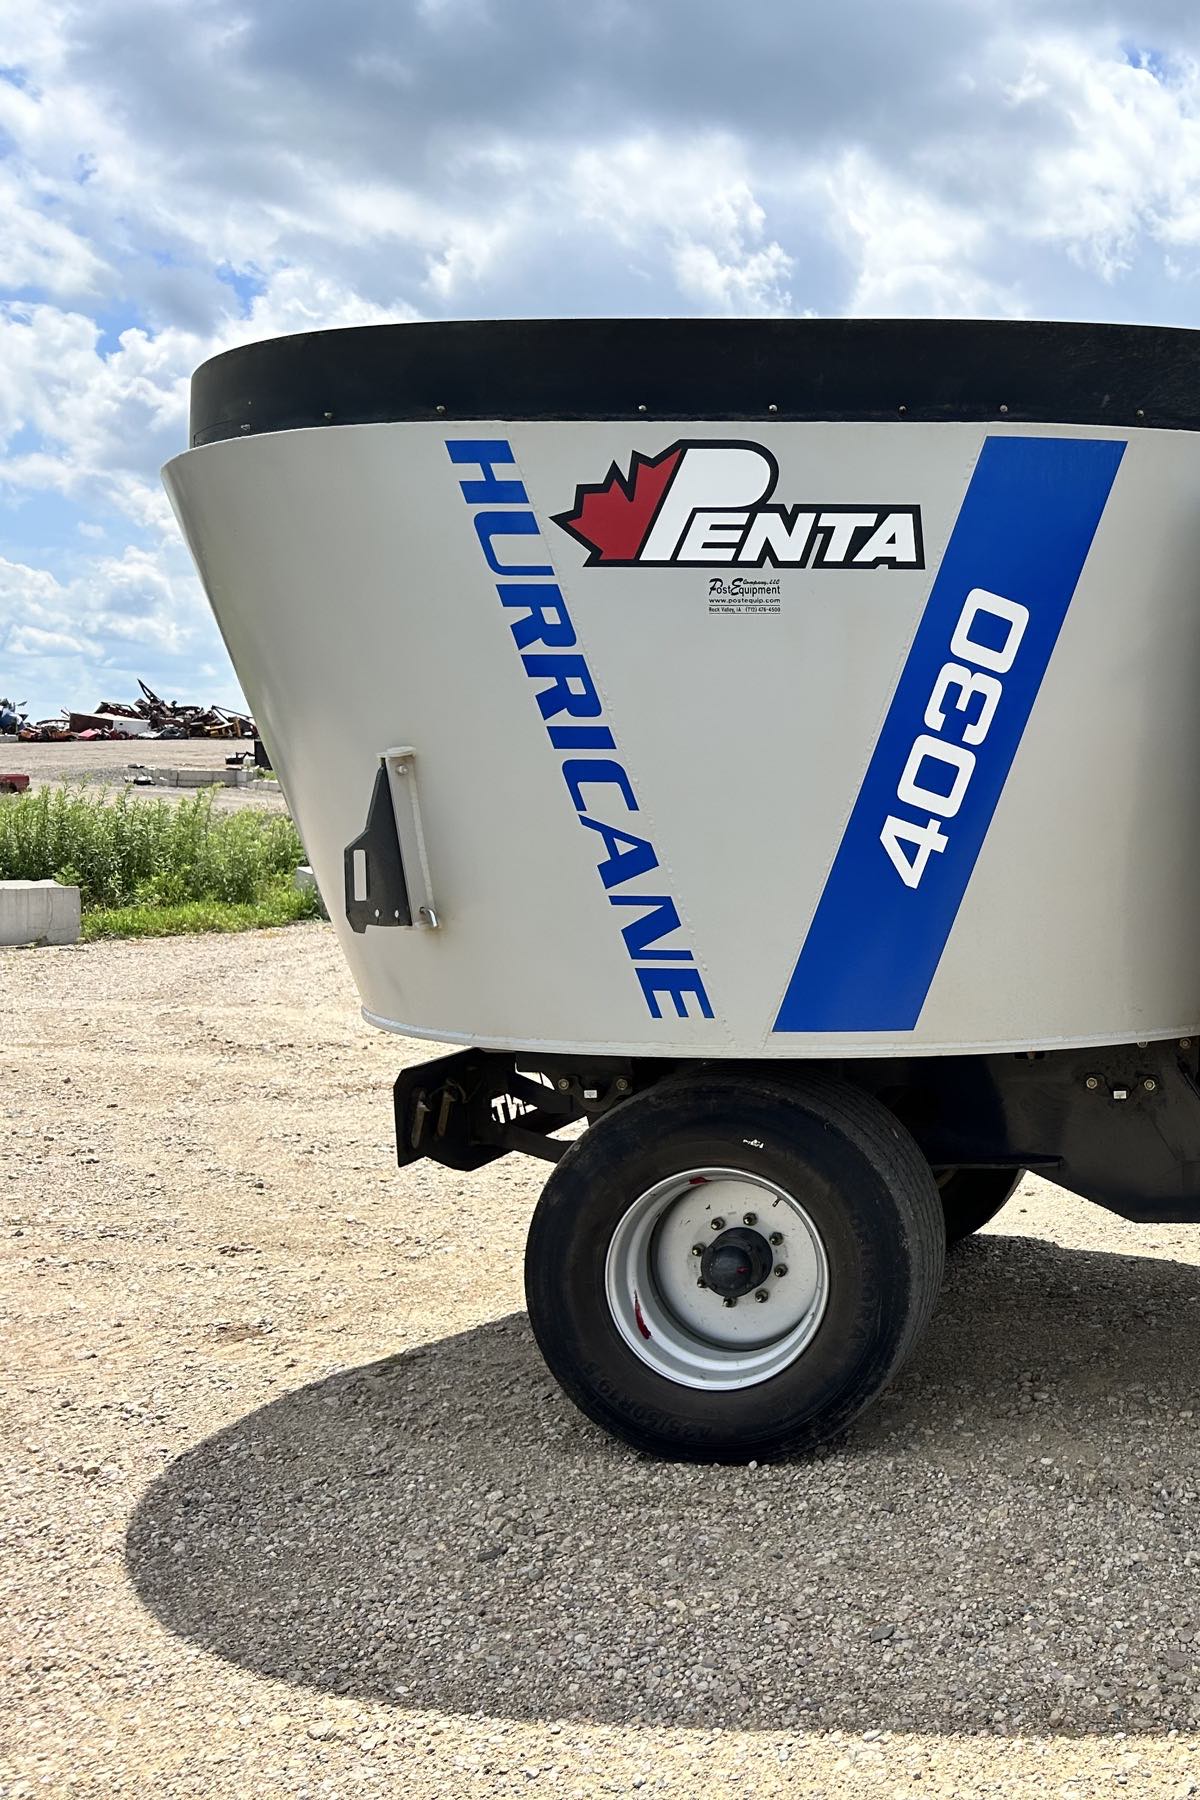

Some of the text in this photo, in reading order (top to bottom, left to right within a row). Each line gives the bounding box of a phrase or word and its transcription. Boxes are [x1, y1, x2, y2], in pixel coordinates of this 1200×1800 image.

[636, 440, 925, 569] PENTA
[445, 440, 714, 1019] HURRICANE
[878, 587, 1030, 890] 4030
